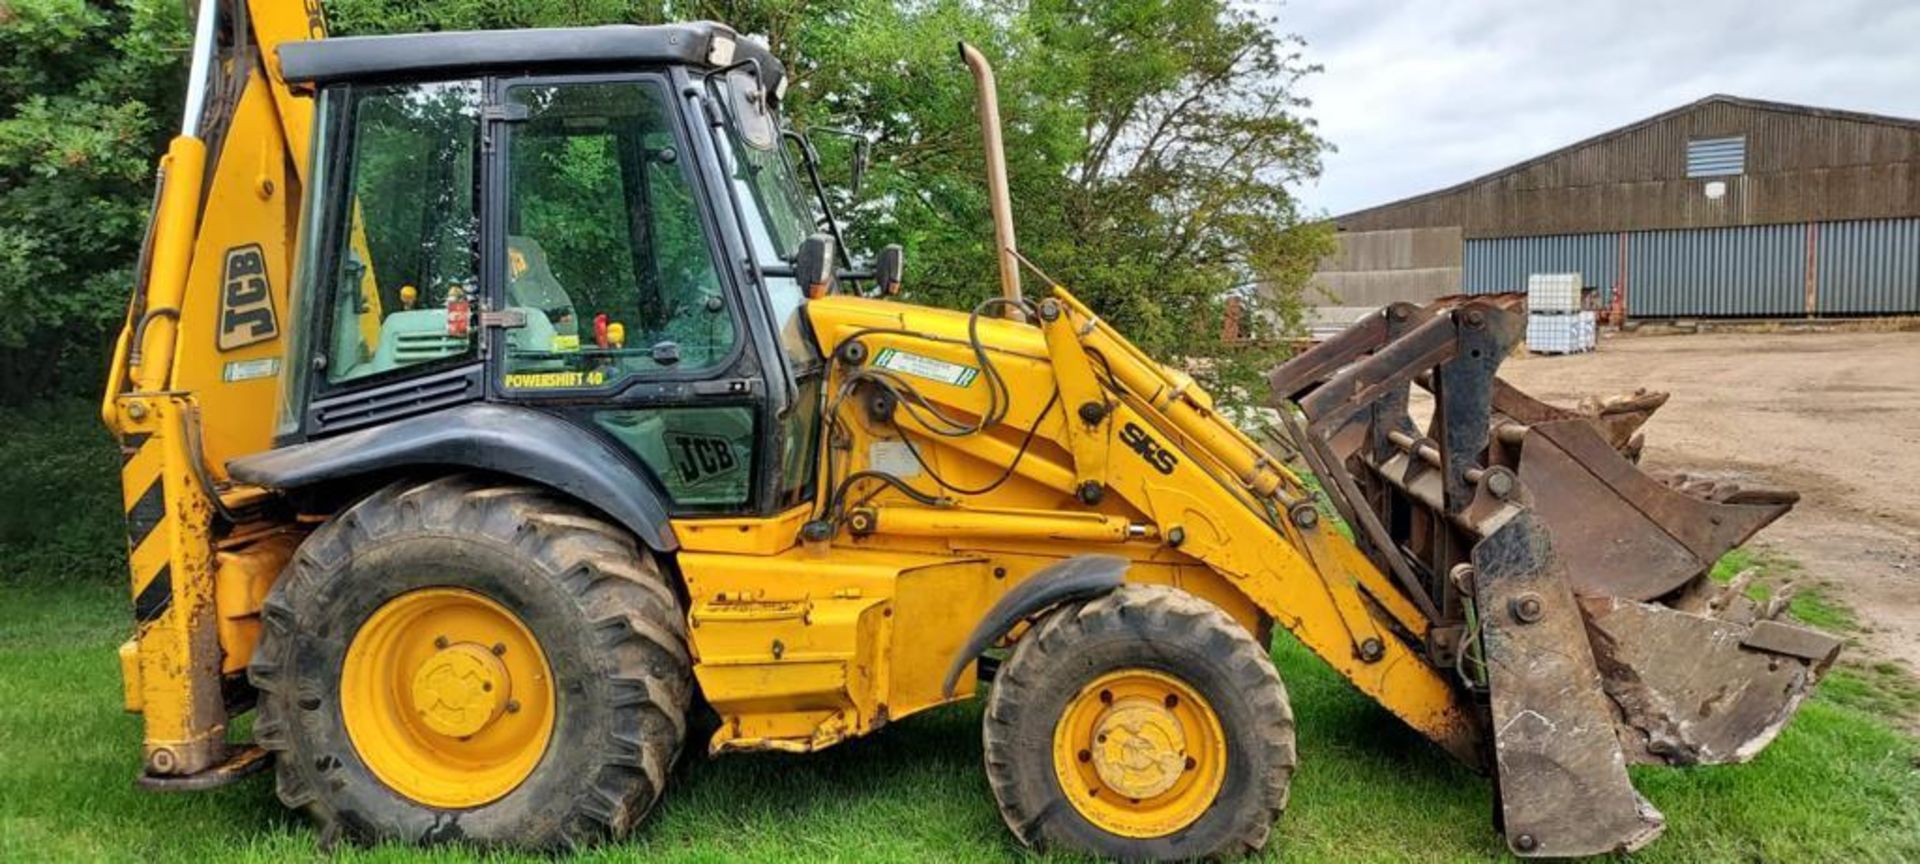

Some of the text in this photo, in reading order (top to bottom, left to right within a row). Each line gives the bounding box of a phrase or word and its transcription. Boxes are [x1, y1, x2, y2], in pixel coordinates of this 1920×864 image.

[224, 251, 274, 337] JCB
[505, 371, 603, 388] POWERSHIFT 40
[675, 436, 734, 482] JCB
